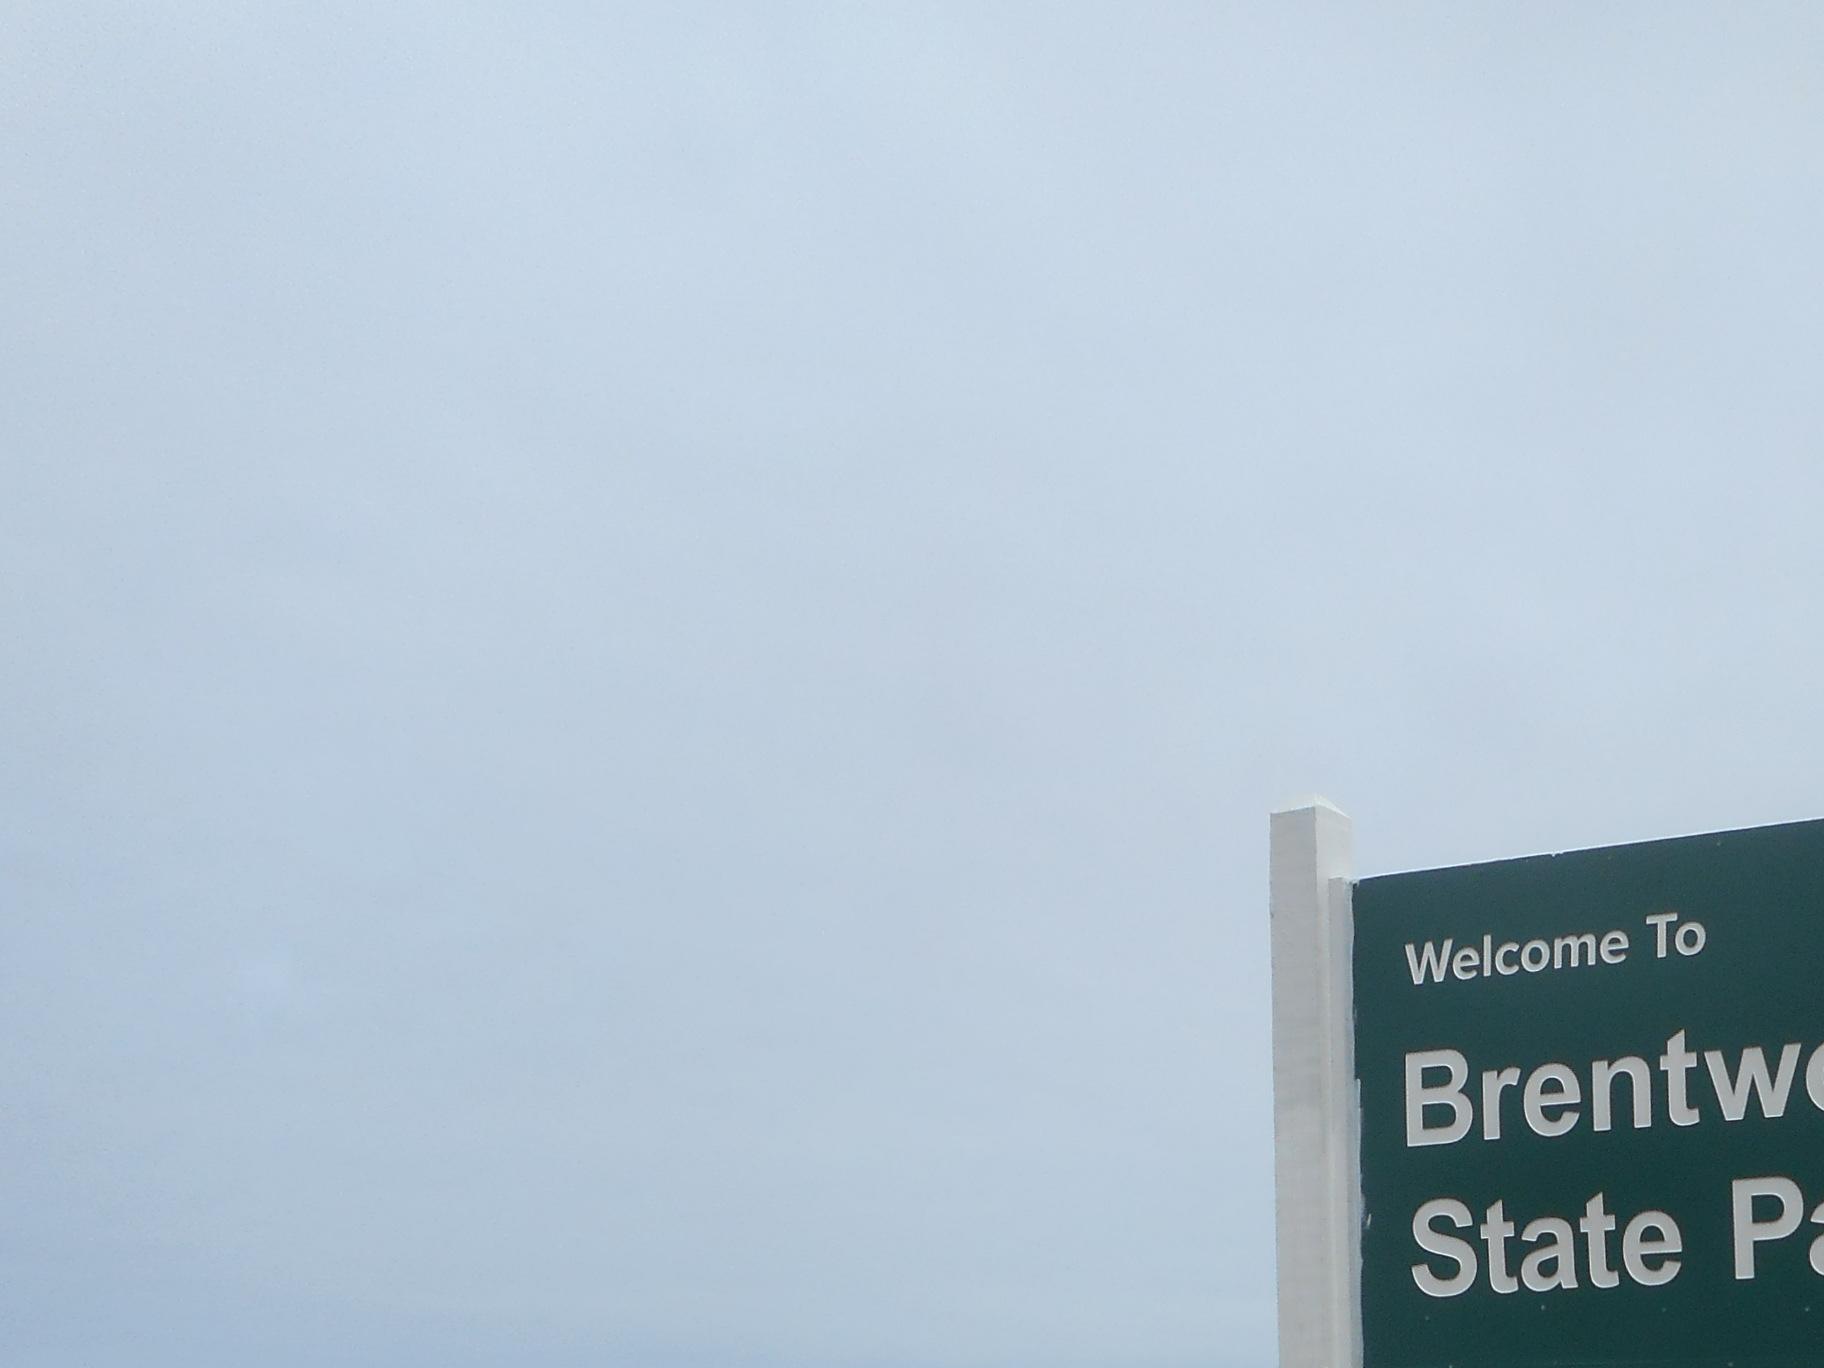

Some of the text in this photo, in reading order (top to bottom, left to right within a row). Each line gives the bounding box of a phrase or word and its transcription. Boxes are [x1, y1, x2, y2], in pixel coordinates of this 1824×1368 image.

[1404, 912, 1708, 986] Welcome To
[1411, 1191, 1683, 1298] State
